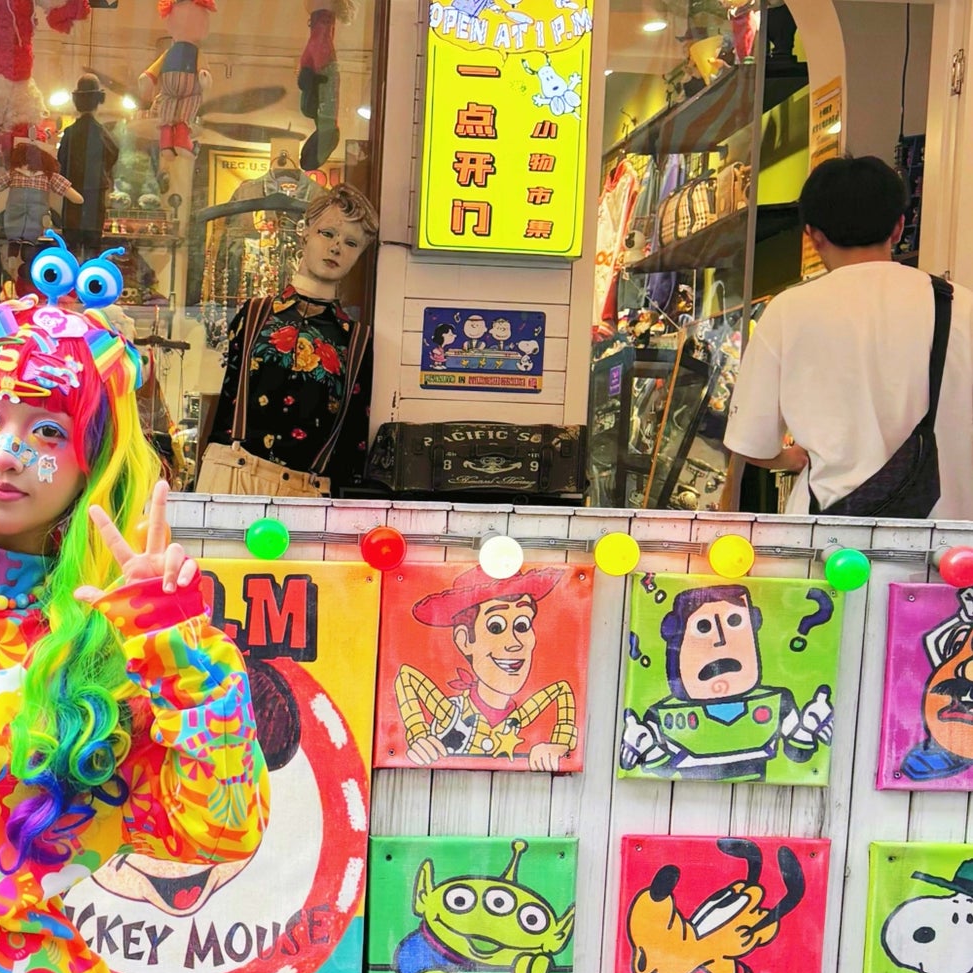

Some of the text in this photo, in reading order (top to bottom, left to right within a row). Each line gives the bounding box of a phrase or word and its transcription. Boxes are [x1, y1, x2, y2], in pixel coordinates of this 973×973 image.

[429, 3, 488, 45] OPEN
[493, 21, 527, 50] AT
[536, 21, 545, 48] 1
[451, 64, 501, 237] 一点开门
[184, 903, 330, 970] MOUSE
